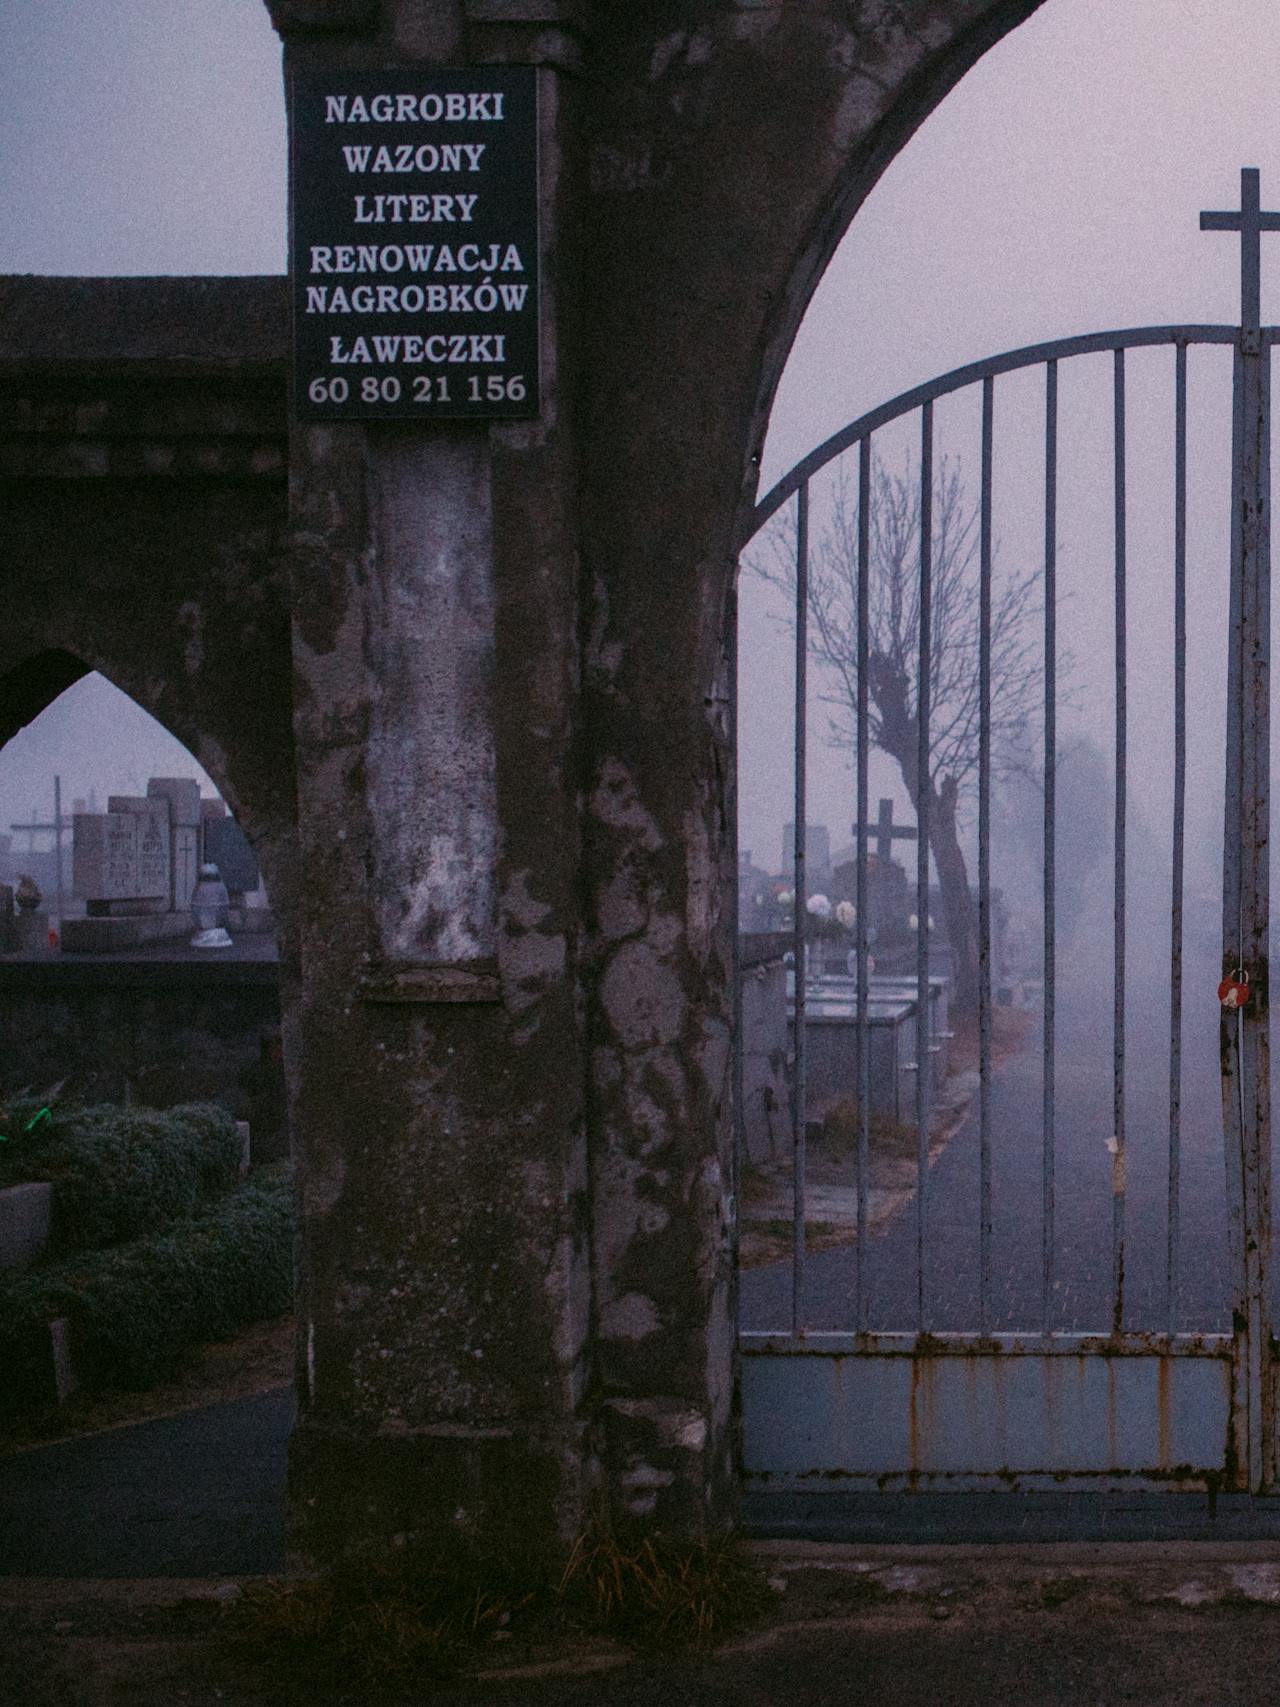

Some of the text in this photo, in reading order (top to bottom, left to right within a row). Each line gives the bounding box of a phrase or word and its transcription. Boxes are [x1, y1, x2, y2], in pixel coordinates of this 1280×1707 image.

[325, 93, 504, 123] NAGROBKI
[342, 144, 486, 173] WAZONY
[354, 195, 478, 223] LITERY
[309, 244, 524, 273] RENOWACJA
[305, 276, 528, 313] NAGROBKÓW
[330, 335, 506, 364] ŁAWECZKI
[309, 375, 526, 402] 60 80 21 156
